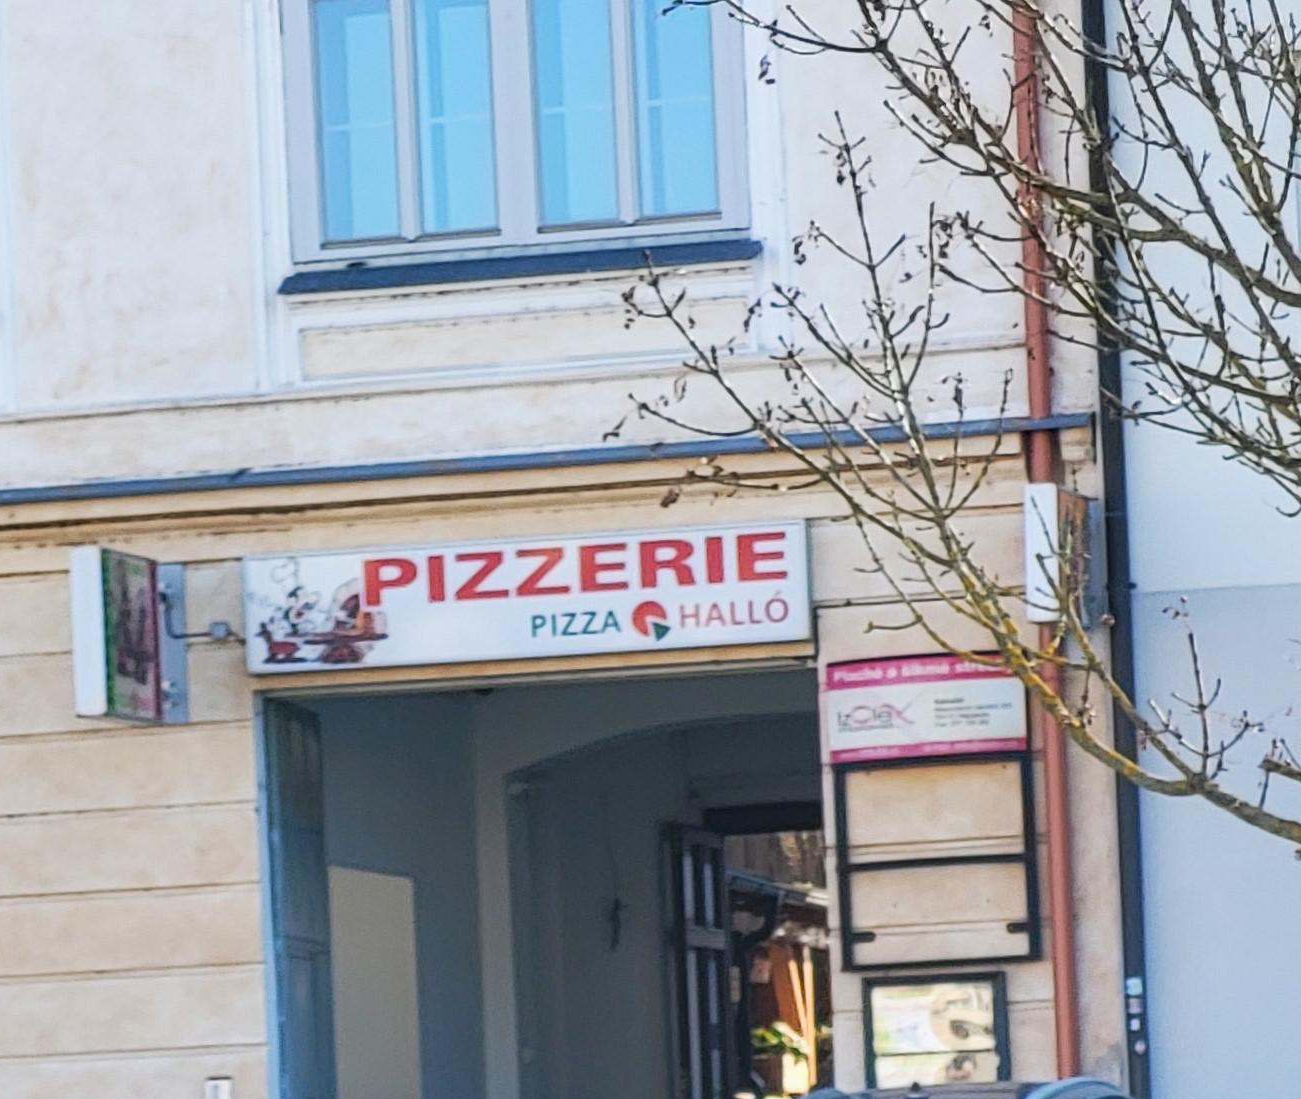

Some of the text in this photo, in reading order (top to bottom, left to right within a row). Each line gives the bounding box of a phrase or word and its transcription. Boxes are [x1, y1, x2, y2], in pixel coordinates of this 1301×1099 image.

[362, 531, 789, 607] PIZZERIE
[531, 592, 790, 638] PIZZA HALLÓ
